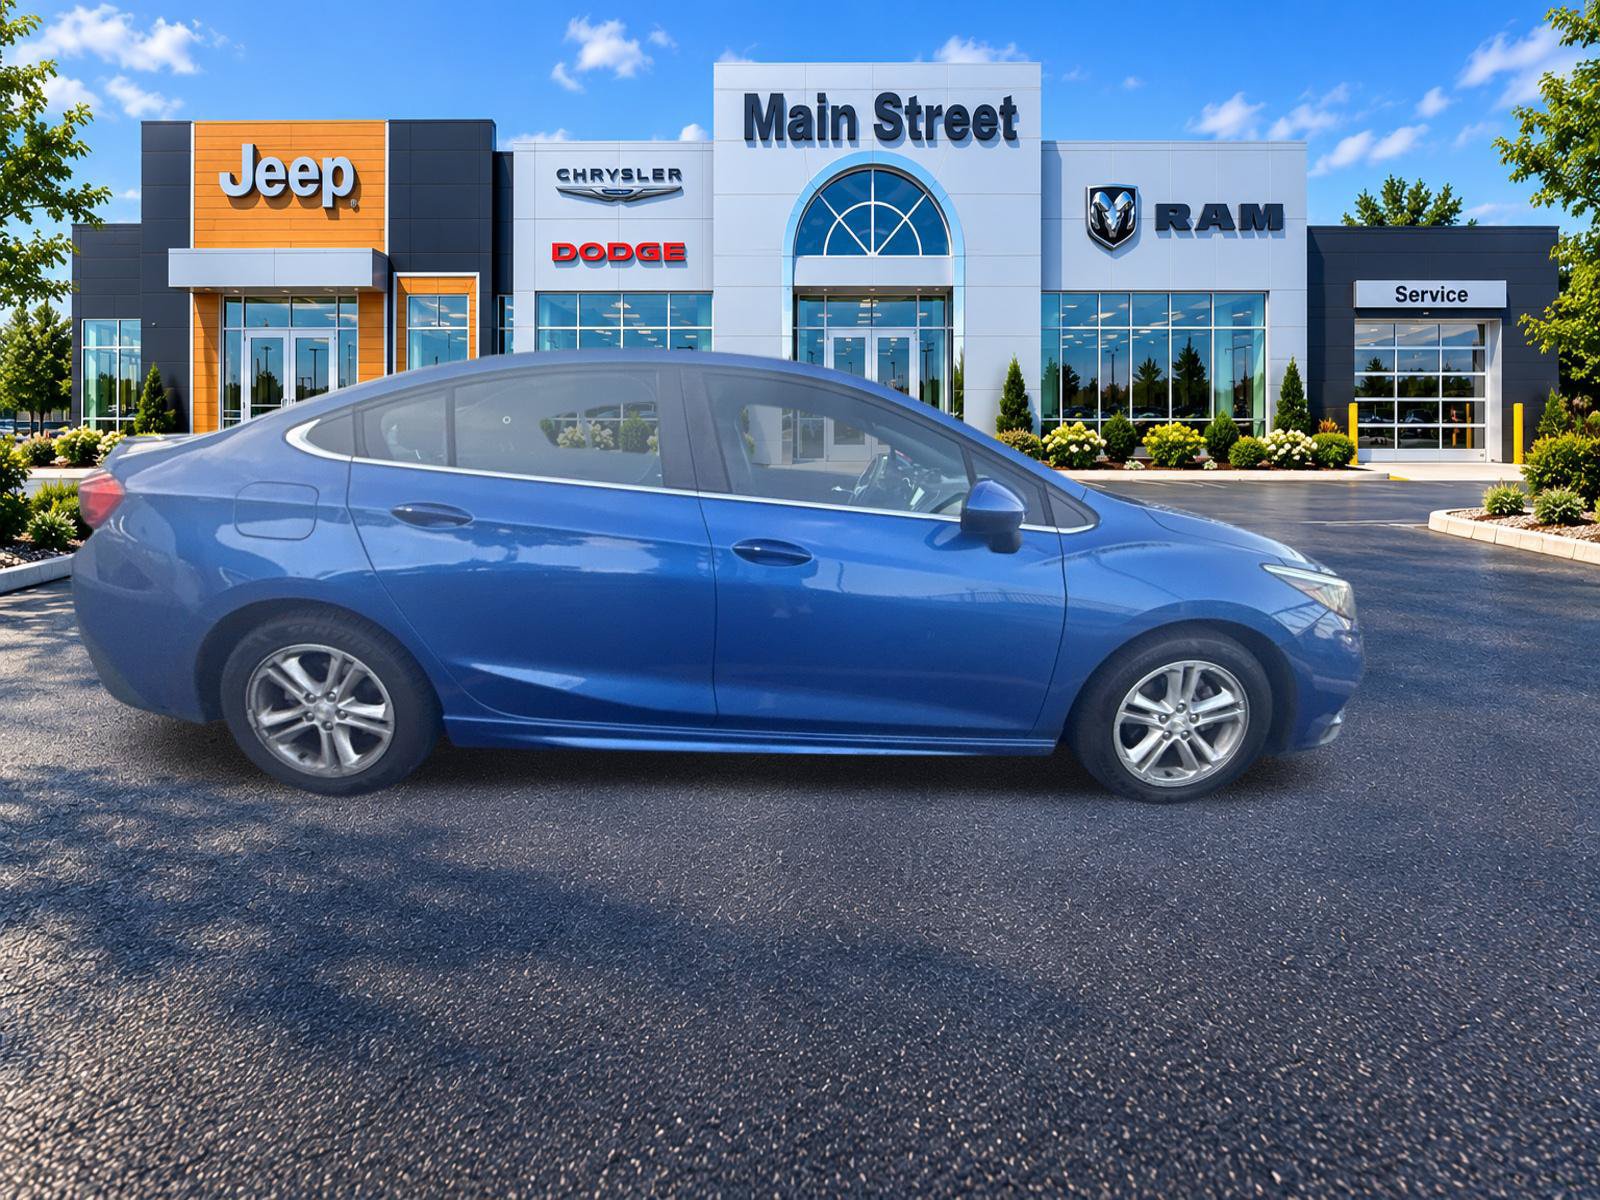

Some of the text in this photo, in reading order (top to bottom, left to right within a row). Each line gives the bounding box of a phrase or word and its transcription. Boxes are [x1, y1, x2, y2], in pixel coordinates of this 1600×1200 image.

[744, 92, 1018, 141] Main Street
[219, 143, 354, 208] Jeep
[556, 168, 682, 183] CHRYSLER
[1155, 203, 1284, 231] RAM
[552, 242, 686, 261] DODGE
[1395, 285, 1468, 303] Service
